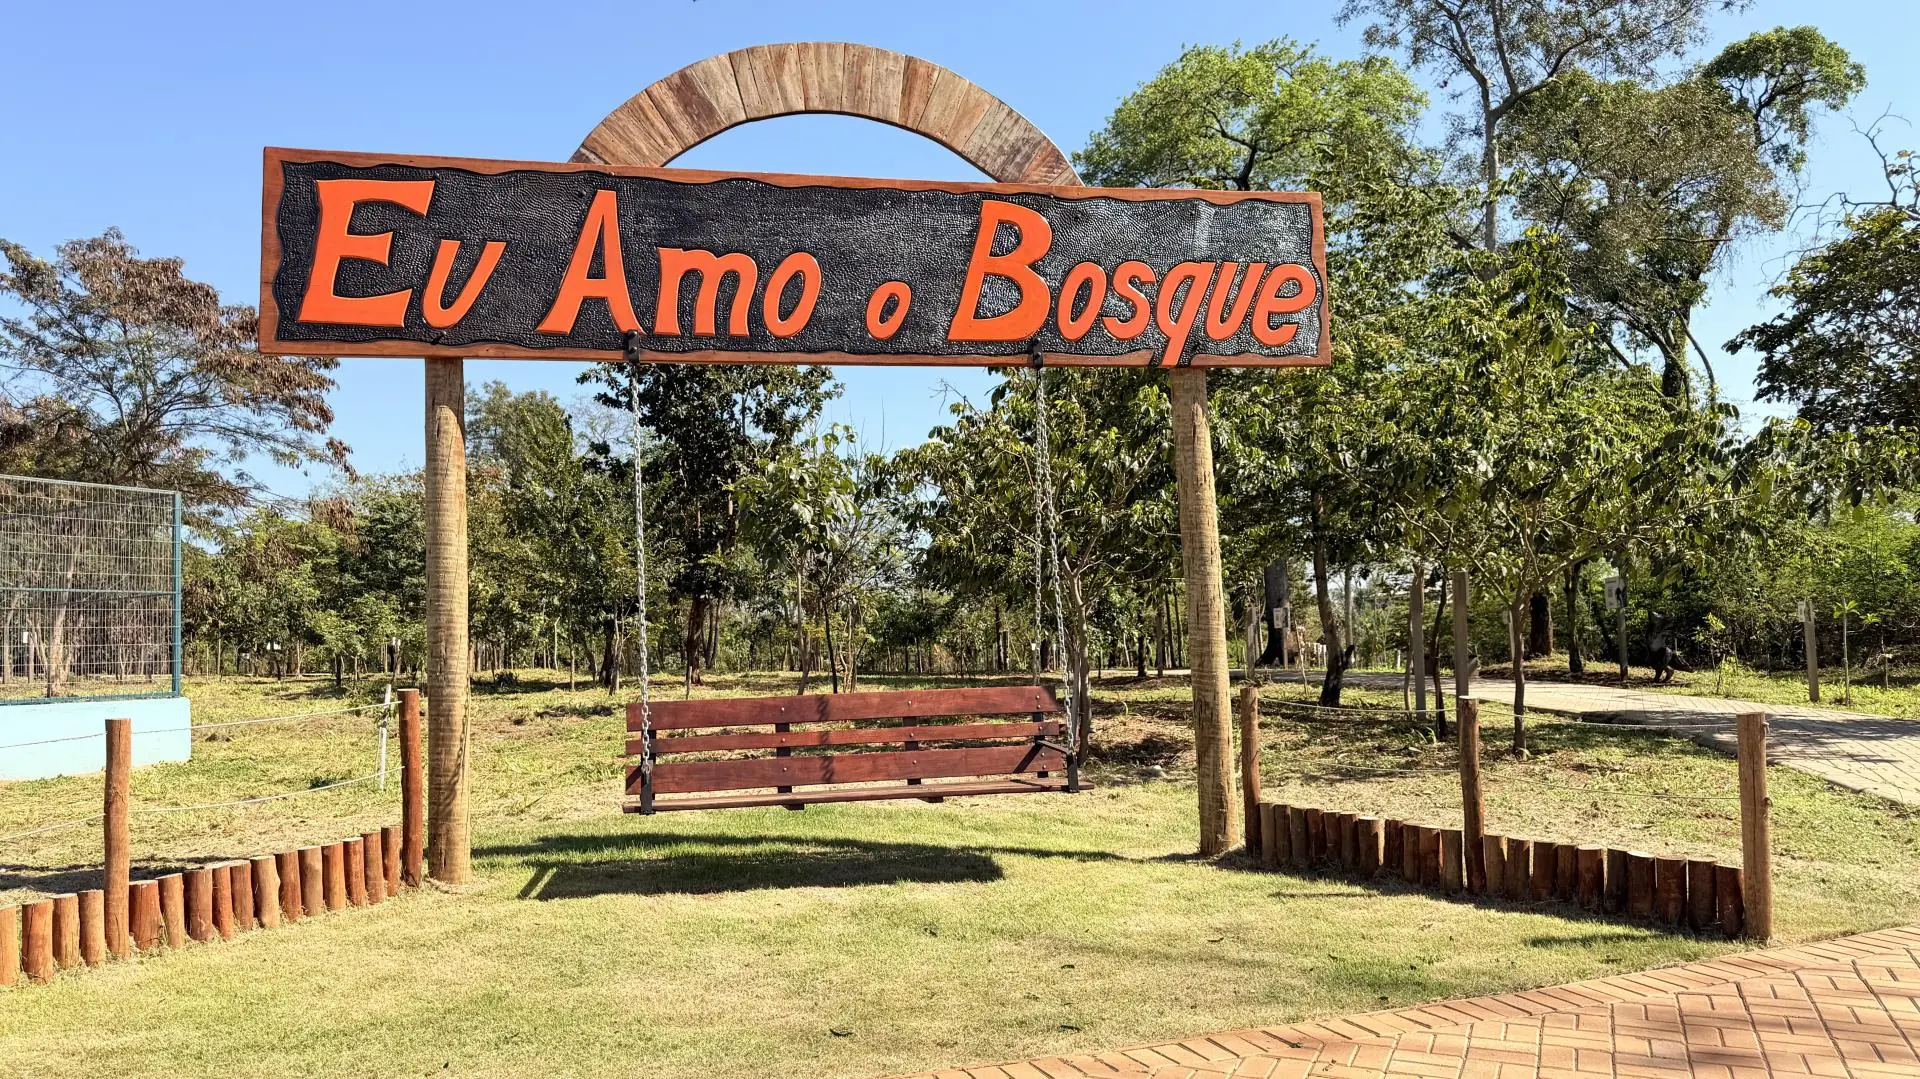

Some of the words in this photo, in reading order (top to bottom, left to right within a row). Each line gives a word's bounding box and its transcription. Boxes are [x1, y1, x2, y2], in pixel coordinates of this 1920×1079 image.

[299, 180, 506, 328] Eu
[537, 189, 822, 337] Amo
[866, 281, 912, 340] o
[946, 200, 1317, 366] Bosque
